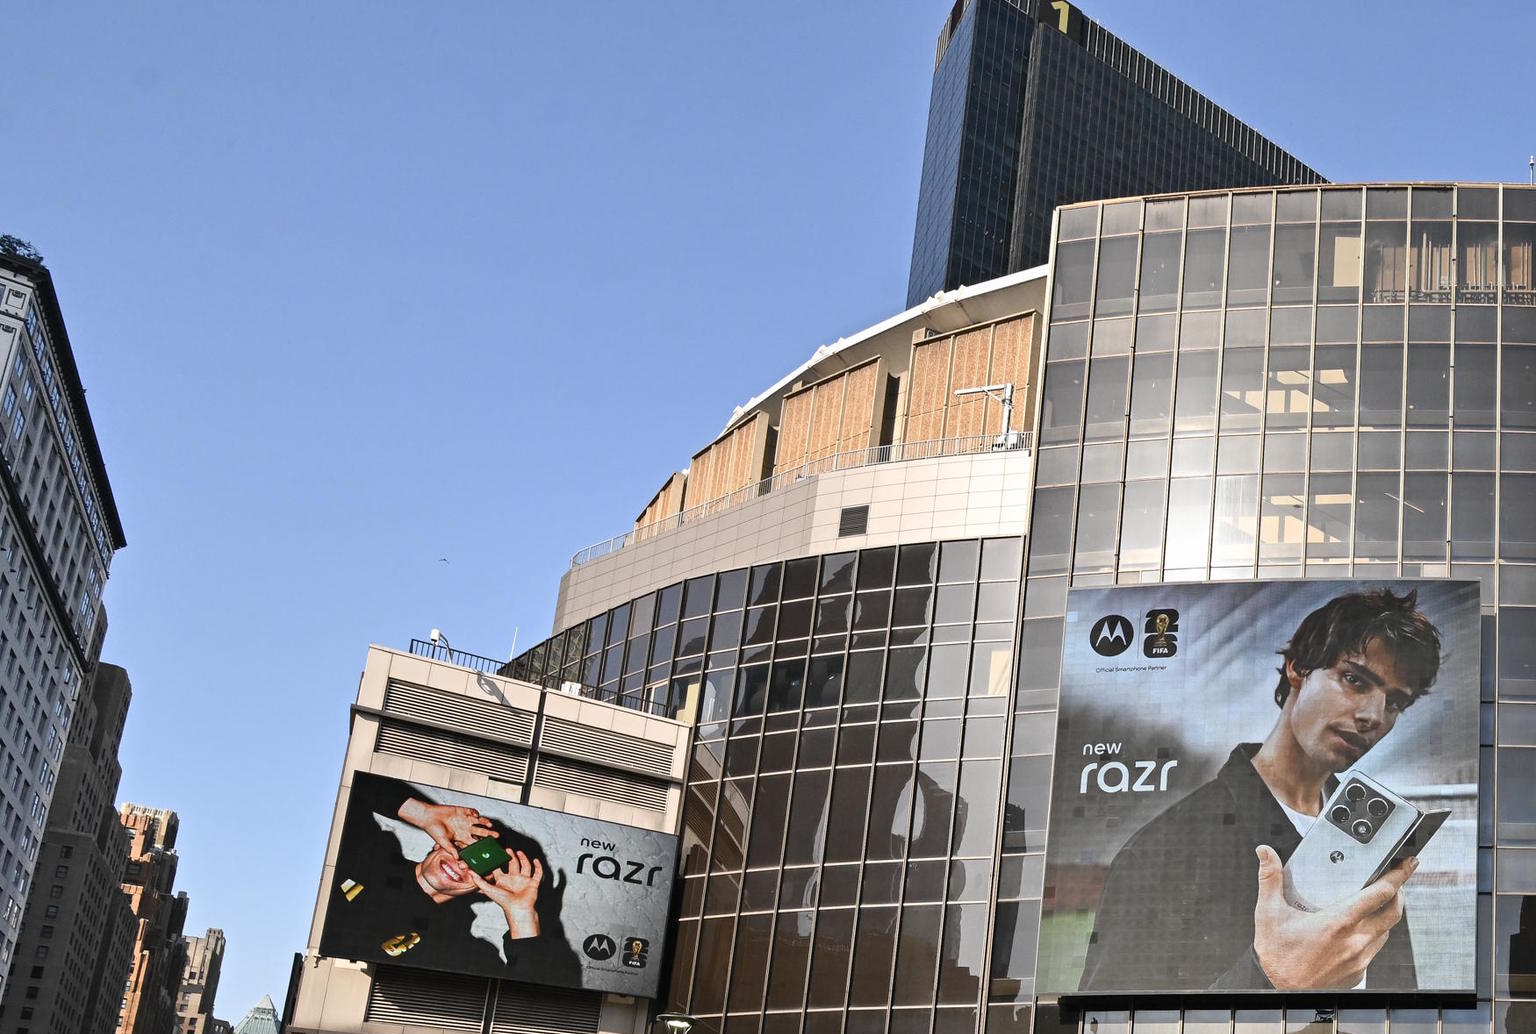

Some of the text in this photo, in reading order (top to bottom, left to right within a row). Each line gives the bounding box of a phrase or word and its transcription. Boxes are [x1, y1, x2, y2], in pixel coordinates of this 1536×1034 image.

[1082, 742, 1122, 756] new
[1079, 760, 1178, 794] razr
[580, 837, 616, 851] new
[576, 853, 663, 886] razr
